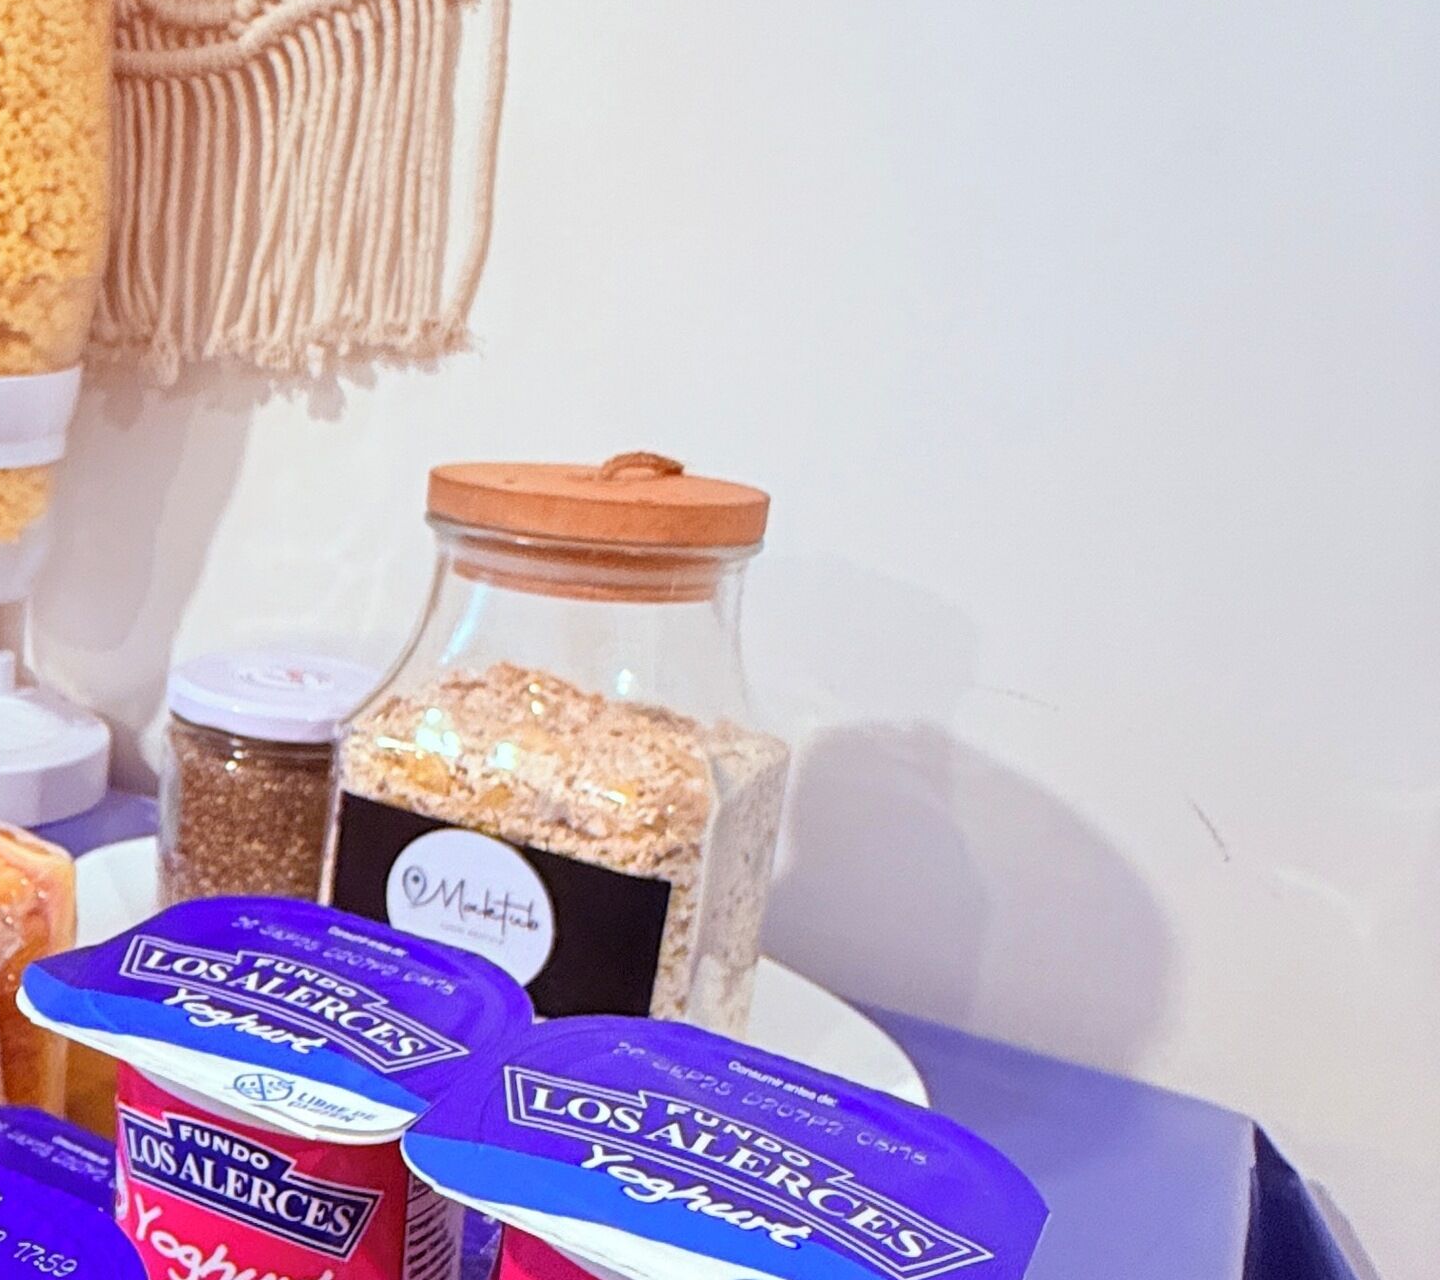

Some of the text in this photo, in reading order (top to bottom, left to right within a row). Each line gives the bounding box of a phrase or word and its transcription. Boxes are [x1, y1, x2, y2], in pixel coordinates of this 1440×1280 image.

[144, 949, 428, 1060] LOS ALERCES
[252, 957, 359, 998] FUNDO
[162, 987, 328, 1055] Yoghurt
[180, 1124, 272, 1170] FUNDO
[666, 1102, 811, 1168] FUNDO
[127, 1126, 178, 1172] LOS
[179, 1157, 358, 1240] ALERCES
[530, 1085, 937, 1260] LOS ALERCES
[582, 1144, 814, 1249] Yoghurt
[13, 1240, 79, 1277] 17:59
